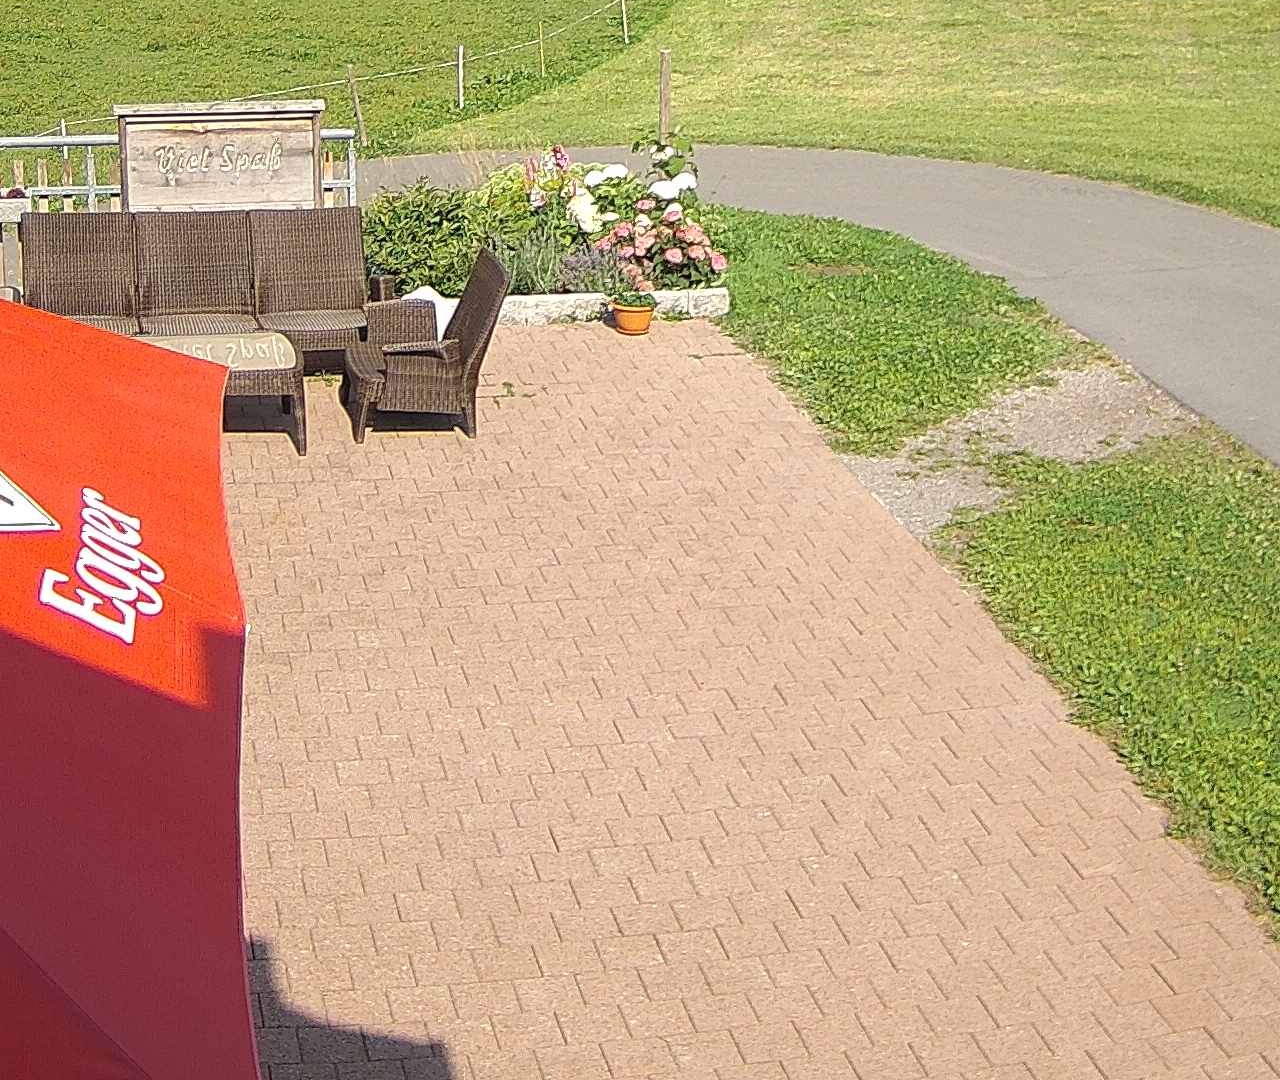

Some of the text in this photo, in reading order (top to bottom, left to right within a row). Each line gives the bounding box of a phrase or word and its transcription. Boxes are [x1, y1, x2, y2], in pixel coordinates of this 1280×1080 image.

[154, 142, 282, 177] Viel Spaß
[38, 487, 166, 644] Egger
